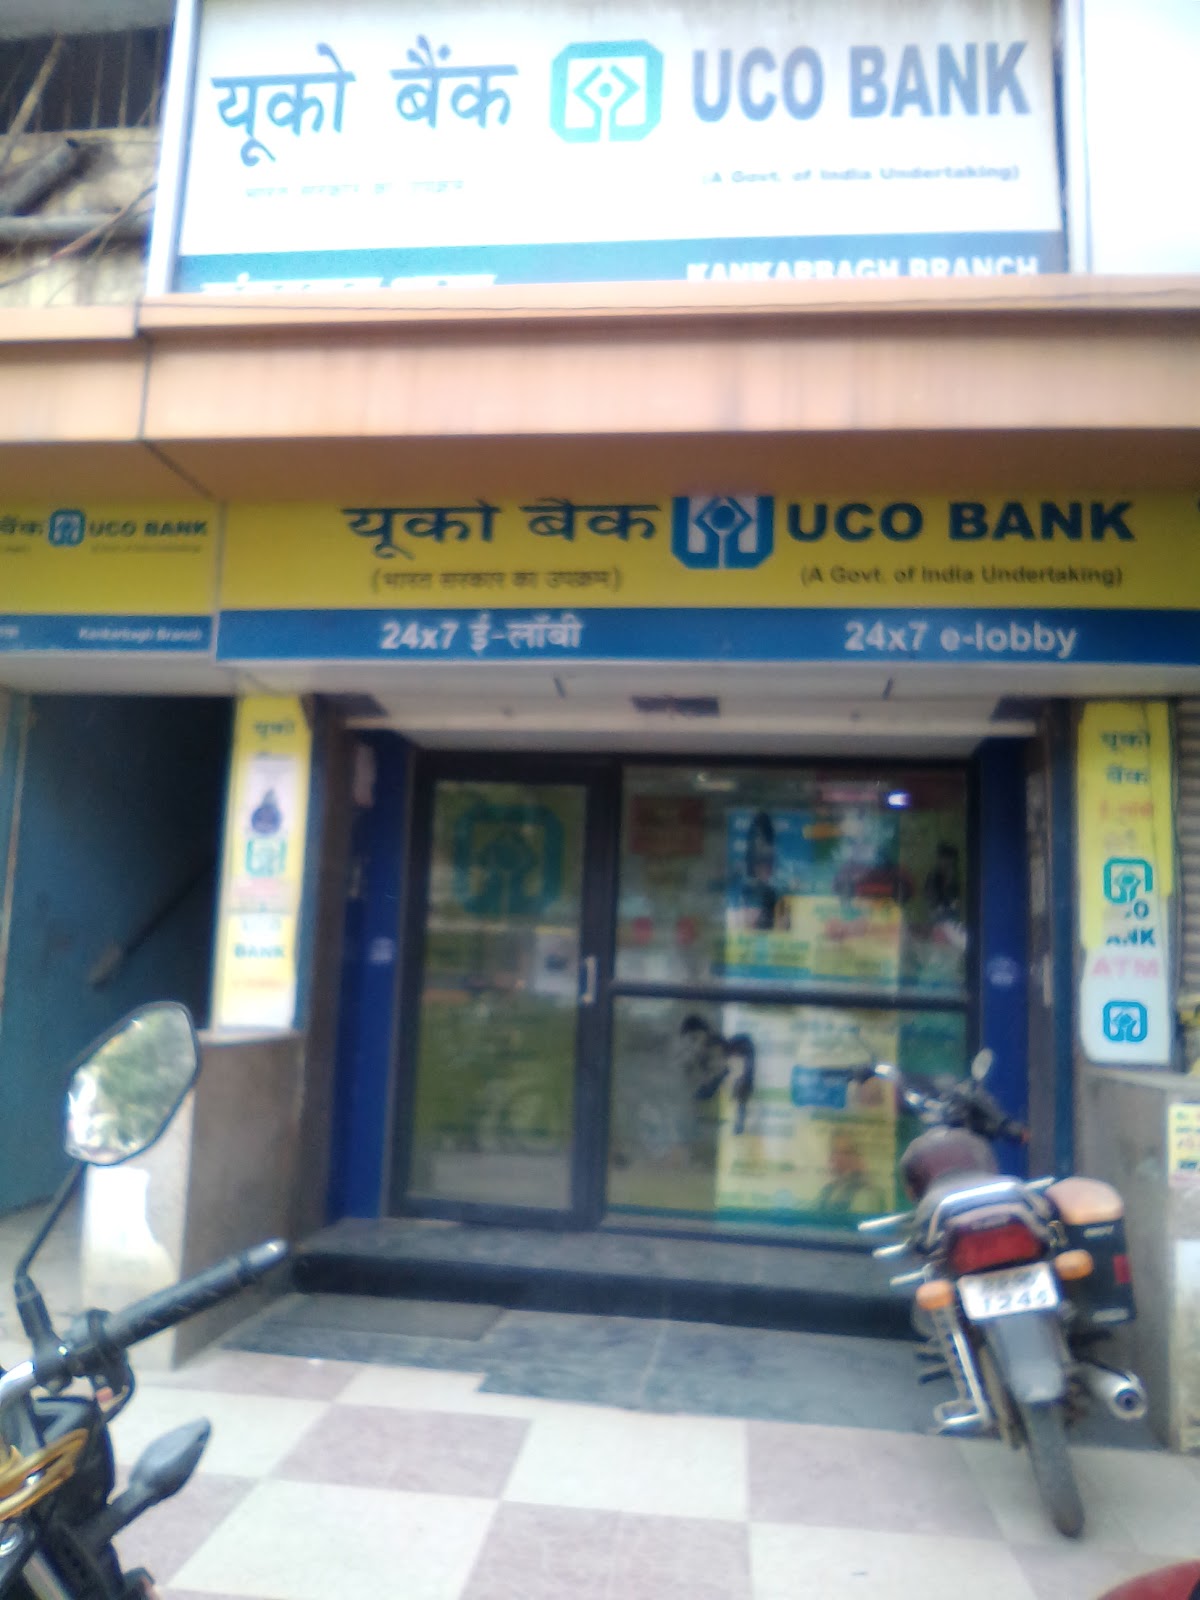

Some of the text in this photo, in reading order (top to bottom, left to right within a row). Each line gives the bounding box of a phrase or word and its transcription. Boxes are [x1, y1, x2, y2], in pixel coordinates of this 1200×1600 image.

[692, 40, 1031, 122] UCO BANK
[210, 34, 519, 166] यूको बैंक
[89, 520, 207, 537] UCO BANK
[787, 501, 1135, 541] UCO BANK
[801, 564, 1123, 588] (A Govt. of India Undertaking)
[379, 619, 459, 650] 24x7
[844, 620, 1077, 659] 24x7 e-lobby
[1092, 955, 1160, 979] ATM
